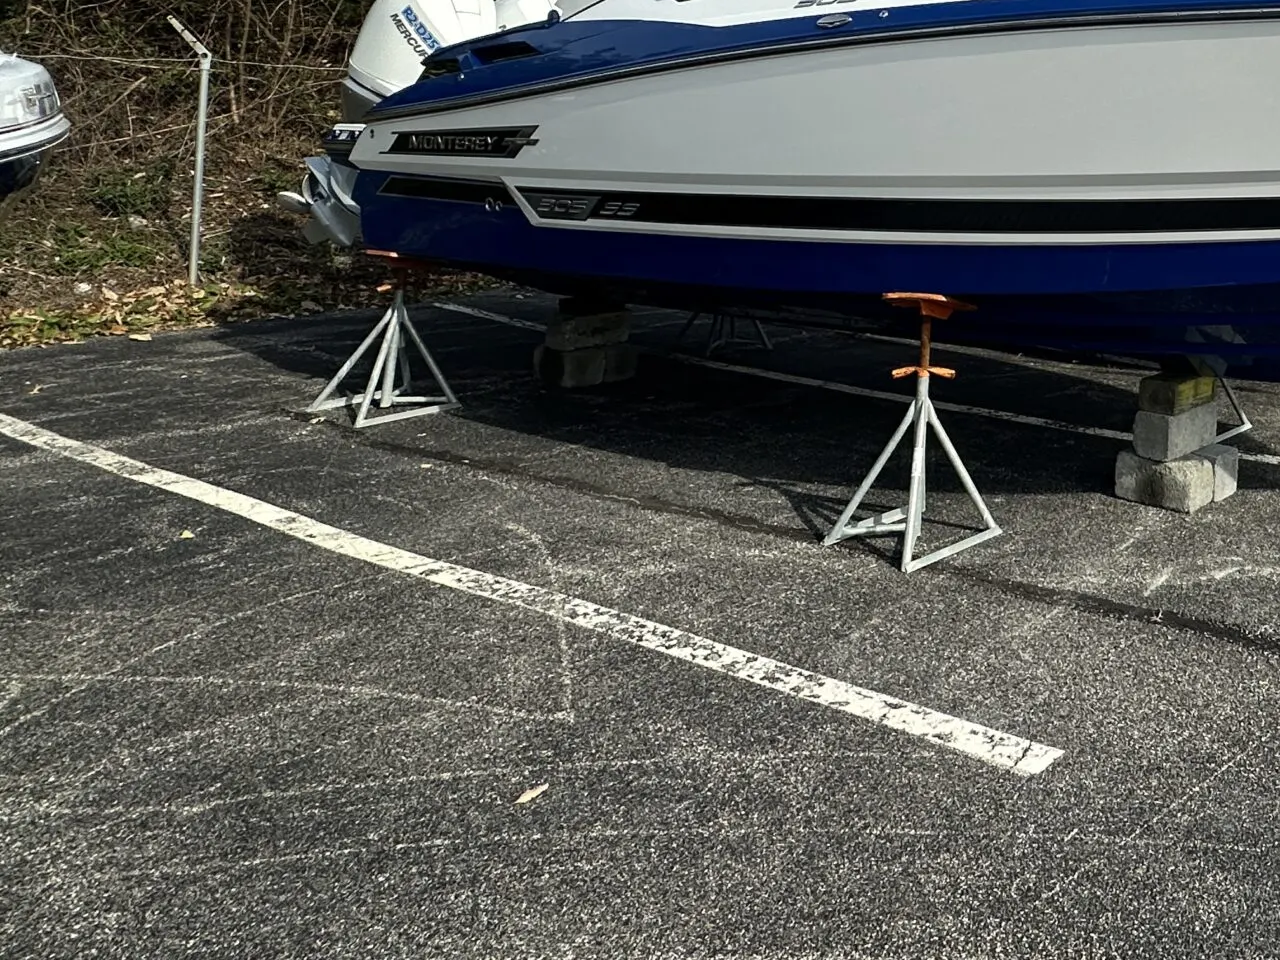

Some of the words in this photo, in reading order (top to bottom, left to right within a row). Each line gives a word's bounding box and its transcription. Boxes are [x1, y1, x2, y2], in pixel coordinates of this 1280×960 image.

[389, 13, 429, 58] MERCUR
[408, 135, 498, 151] MONTEREY
[536, 198, 588, 214] 305
[600, 201, 640, 216] SS
